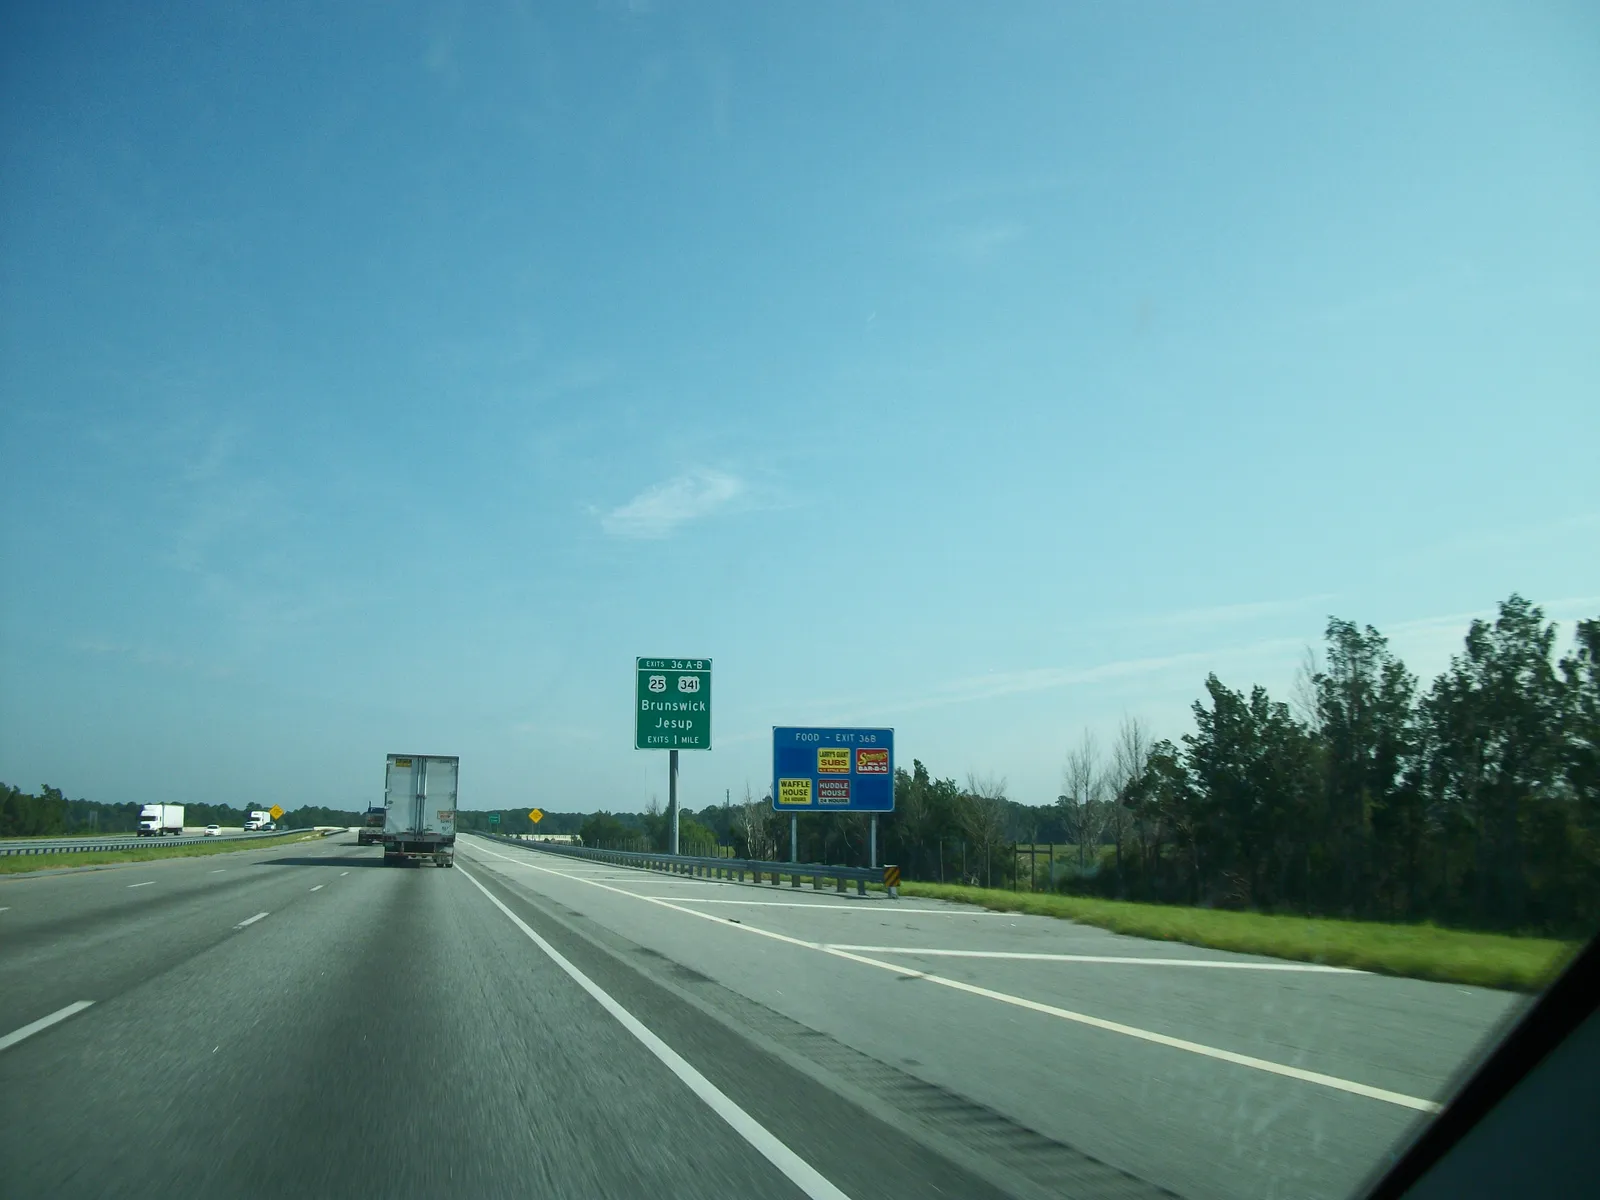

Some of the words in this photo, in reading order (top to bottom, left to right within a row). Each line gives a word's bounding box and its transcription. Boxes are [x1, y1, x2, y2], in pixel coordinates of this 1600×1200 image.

[671, 660, 683, 669] 36
[650, 679, 665, 689] 25
[680, 679, 698, 690] 341
[641, 699, 706, 711] Brunswick
[655, 717, 693, 731] Jesup
[647, 735, 669, 744] EXITS
[681, 736, 699, 744] MILE
[795, 732, 820, 742] FOOD
[835, 733, 855, 742] EXIT
[859, 734, 876, 743] 36B
[780, 780, 810, 788] WAFFLE
[782, 788, 808, 796] HOUSE
[821, 789, 847, 797] HOUSE
